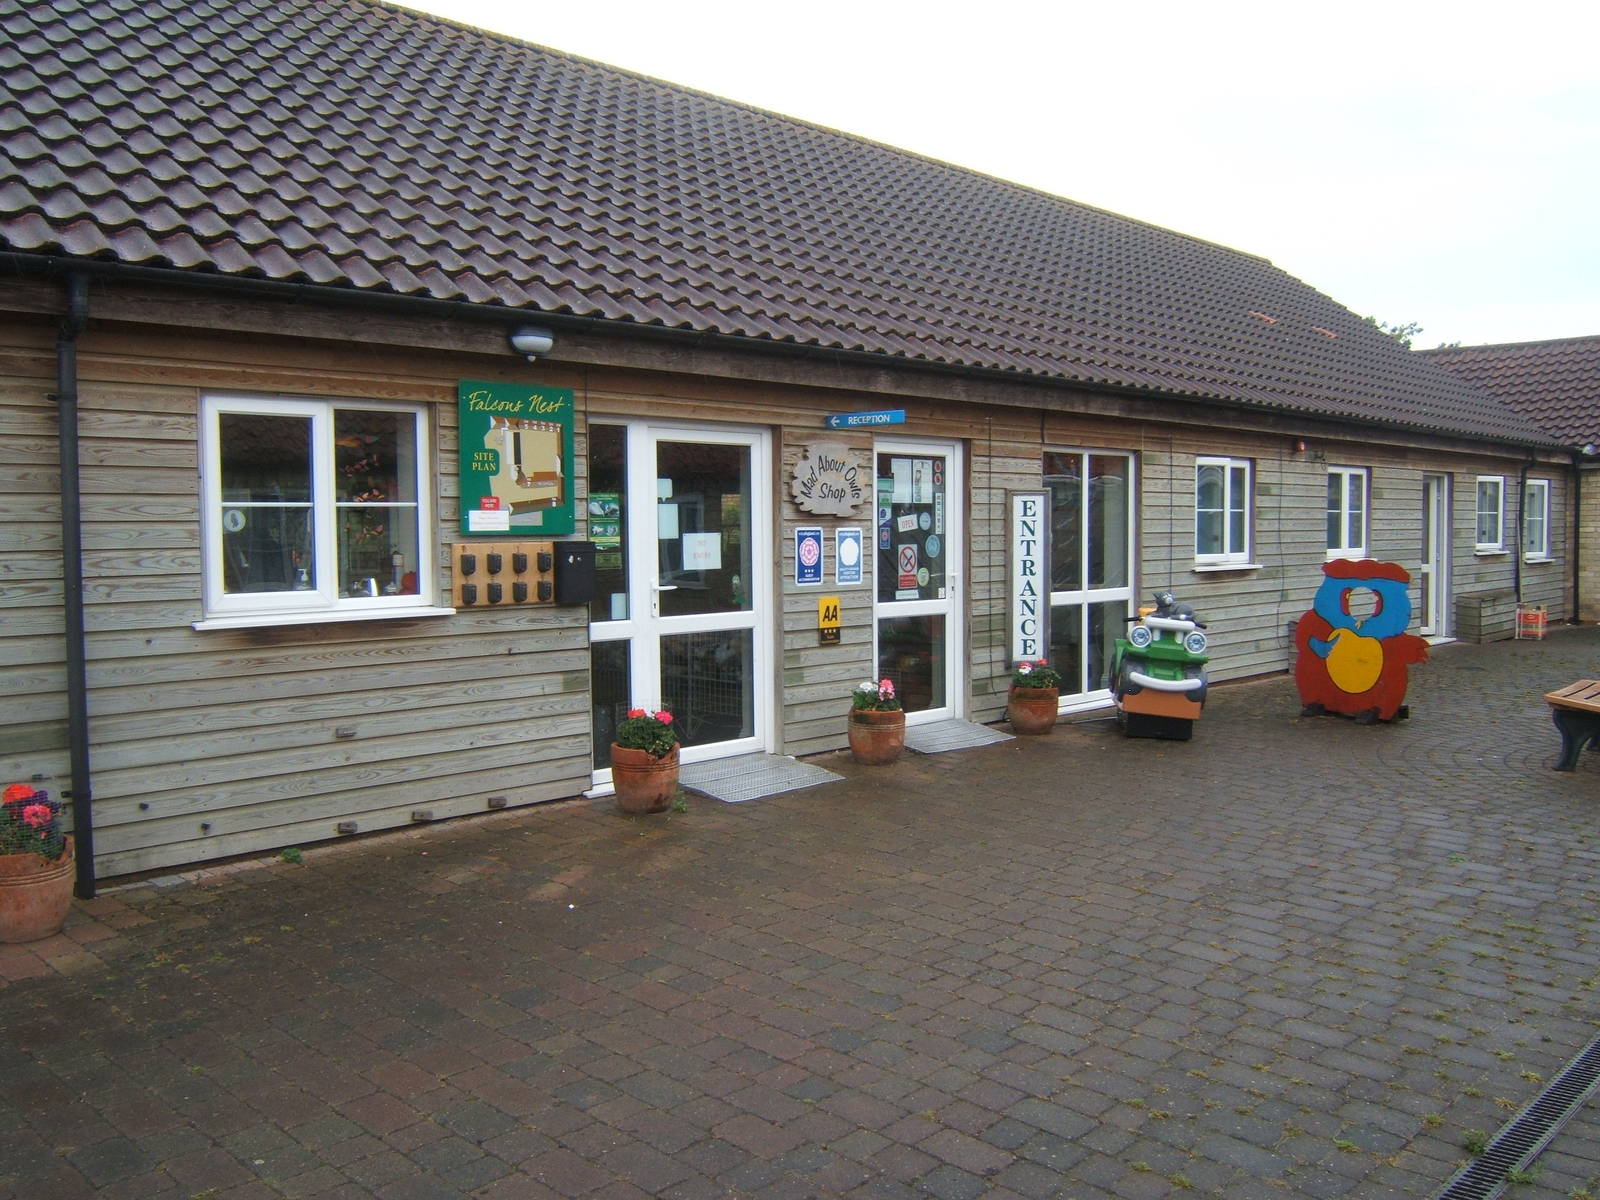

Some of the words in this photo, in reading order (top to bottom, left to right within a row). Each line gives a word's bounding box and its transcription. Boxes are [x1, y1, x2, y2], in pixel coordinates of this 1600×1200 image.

[469, 390, 524, 412] Falcons
[528, 394, 565, 414] Nest
[848, 414, 890, 425] RECEPTION
[474, 452, 494, 461] SITE
[472, 462, 496, 471] PLAN
[800, 466, 818, 499] Mad
[818, 455, 846, 476] About
[844, 467, 862, 499] Owls
[818, 482, 846, 503] Shop
[901, 519, 914, 529] OPEN
[1019, 500, 1037, 656] ENTRANCE
[822, 605, 838, 622] AA
